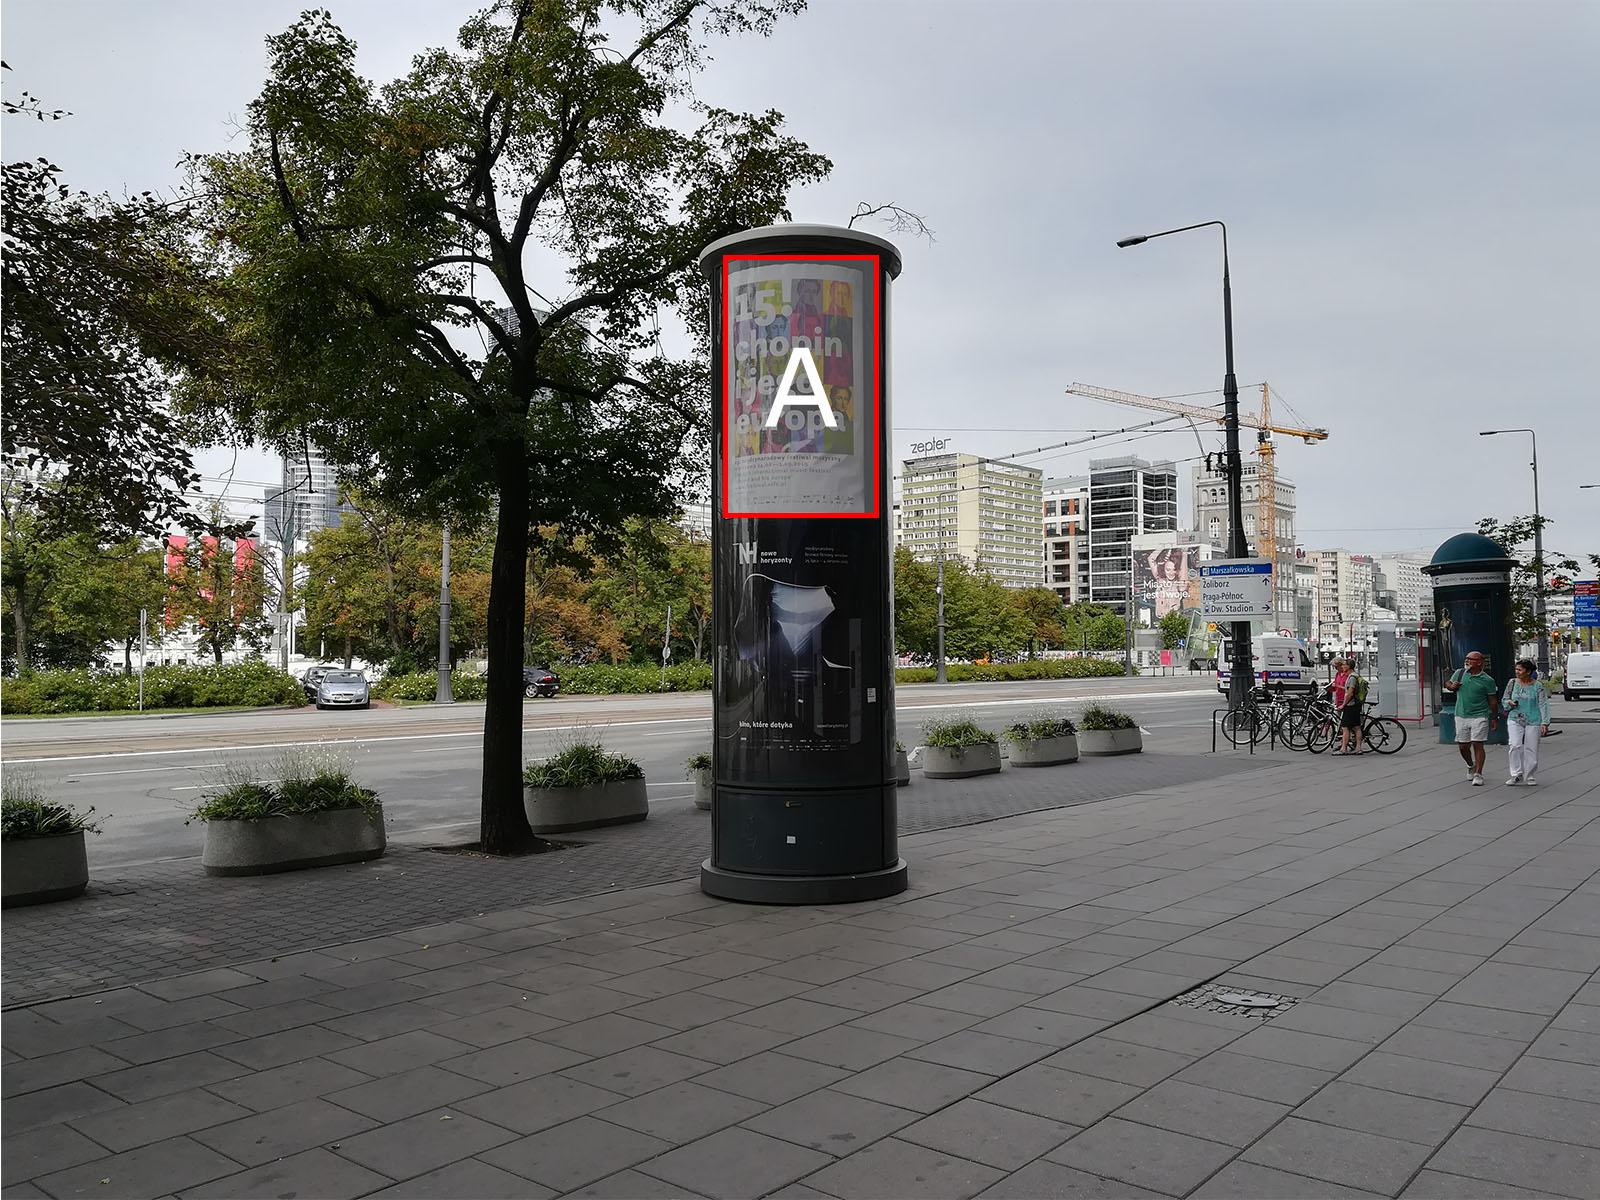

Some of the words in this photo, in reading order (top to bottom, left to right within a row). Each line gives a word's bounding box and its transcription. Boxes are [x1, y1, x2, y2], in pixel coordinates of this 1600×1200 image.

[735, 326, 843, 362] chopin
[737, 408, 847, 439] euopa
[910, 437, 951, 456] zepter
[1143, 579, 1173, 589] Miasto
[1202, 592, 1244, 602] Praga-Północ
[1211, 605, 1224, 613] Dw.
[1225, 603, 1254, 613] Stadion
[752, 720, 769, 729] które
[769, 721, 793, 730] dotyka
